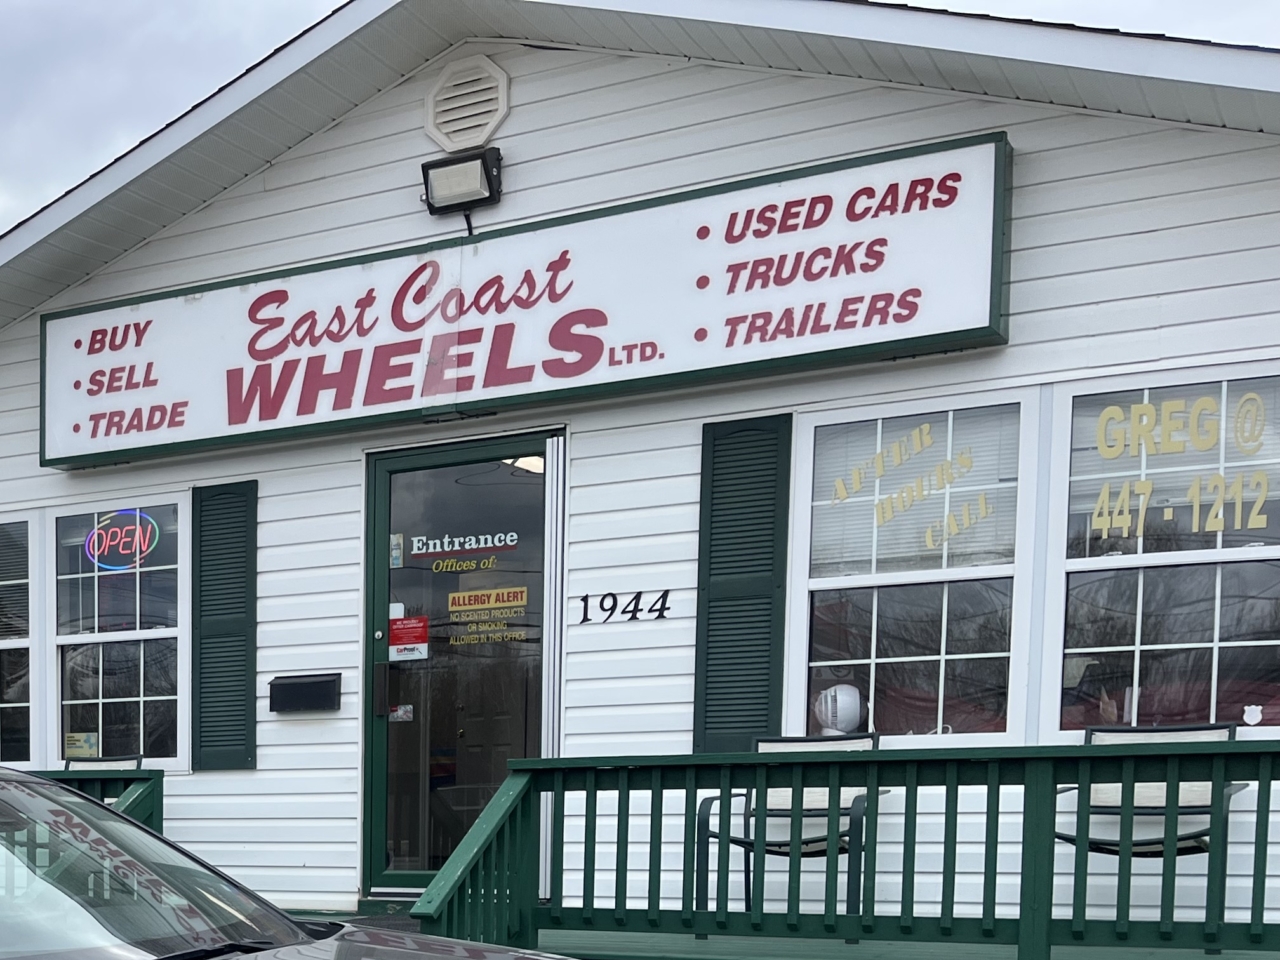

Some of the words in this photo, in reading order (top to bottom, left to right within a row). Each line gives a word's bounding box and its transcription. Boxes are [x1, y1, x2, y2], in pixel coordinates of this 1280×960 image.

[724, 193, 833, 245] USED
[845, 172, 962, 224] CARS
[725, 237, 888, 296] TRUCKS
[247, 286, 379, 362] East
[390, 249, 573, 333] Coast
[724, 288, 922, 349] TRAILERS
[87, 320, 153, 355] BUY
[86, 361, 159, 397] SELL
[226, 308, 608, 426] WHEELS
[608, 340, 666, 367] LTD.
[88, 400, 189, 439] TRADE
[1096, 396, 1219, 460] GREG
[1233, 392, 1266, 455] @
[830, 422, 934, 505] AFTER
[874, 446, 974, 527] HOURS
[924, 491, 996, 550] CALL
[89, 523, 152, 557] OPEN
[410, 531, 518, 554] Entrance
[432, 558, 477, 573] Offices
[480, 555, 497, 569] of:
[449, 612, 459, 622] NO
[461, 610, 489, 620] SCENTED
[491, 607, 525, 618] PRODUCTS
[451, 593, 492, 608] ALLERGY
[495, 590, 525, 604] ALERT
[579, 589, 671, 625] 1944
[449, 635, 479, 645] ALLOWED
[480, 634, 487, 643] IN
[489, 632, 502, 642] THIS
[503, 630, 526, 641] OFFICE
[467, 623, 477, 632] OR
[478, 620, 507, 631] SMOKING
